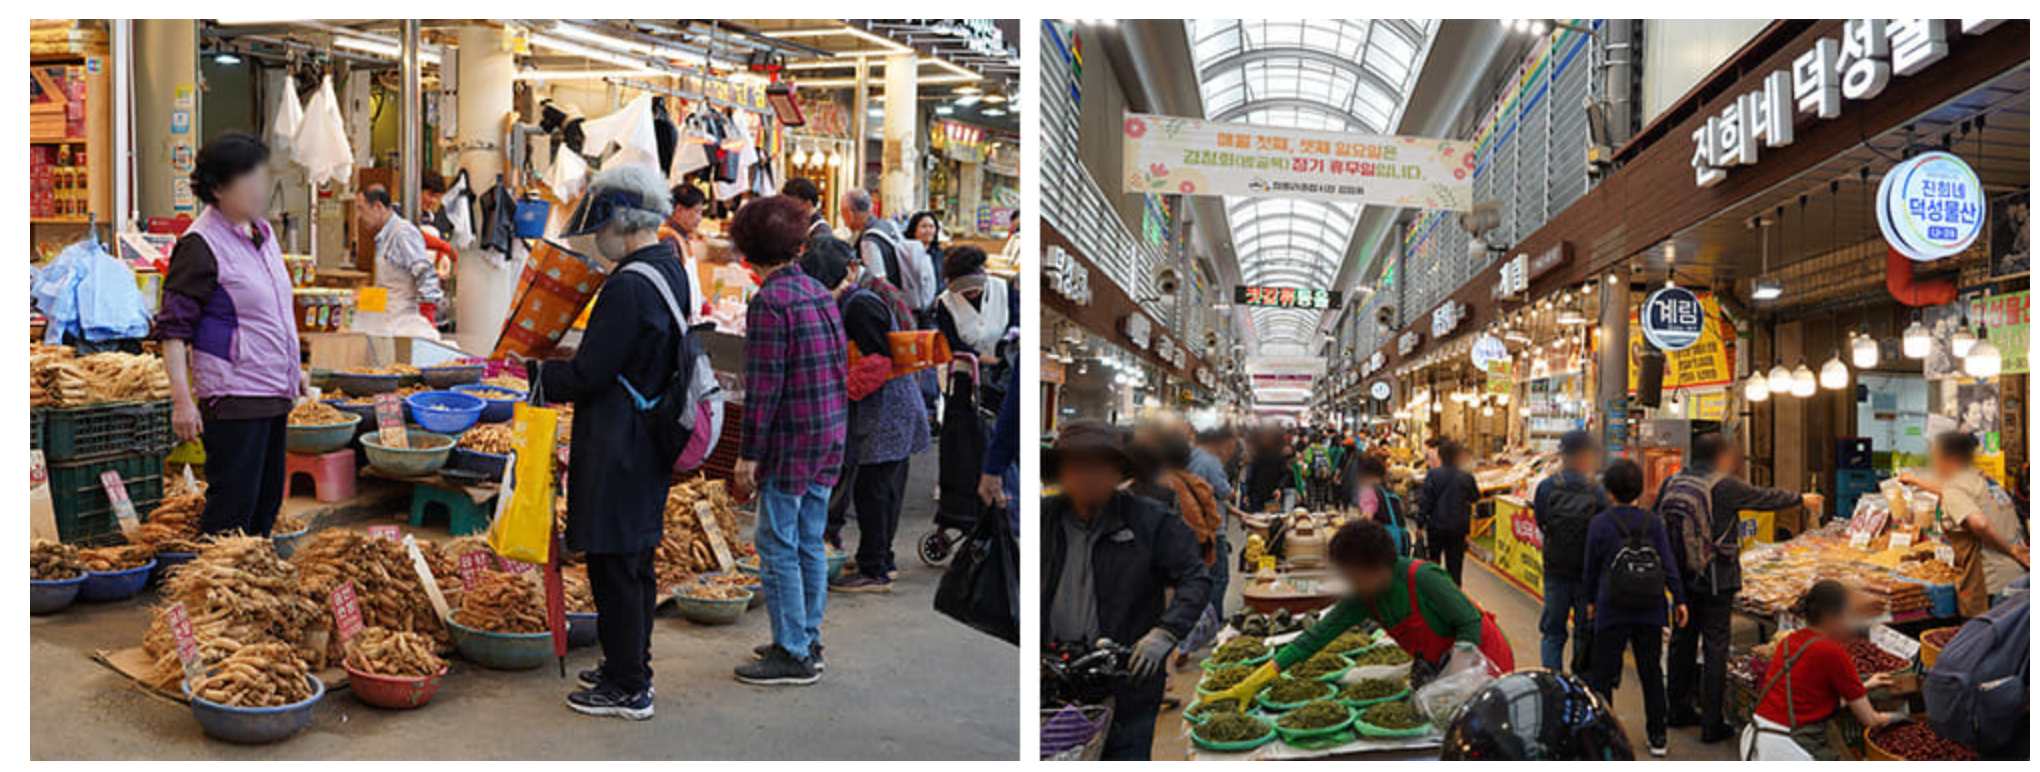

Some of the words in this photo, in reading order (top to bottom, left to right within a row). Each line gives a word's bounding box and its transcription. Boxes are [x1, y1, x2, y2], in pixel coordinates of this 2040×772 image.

[1691, 70, 1793, 186] 진희네
[1793, 18, 2007, 118] 덕성물
[1216, 132, 1251, 149] 매월
[1257, 134, 1294, 153] 첫째,
[1299, 138, 1330, 155] 셋째
[1336, 142, 1397, 160] 일요일은
[1292, 157, 1325, 173] 정기
[1330, 160, 1426, 180] 휴무일입니다.
[1921, 179, 1966, 199] 진희네
[1909, 198, 1976, 224] 덕성물산
[1655, 298, 1698, 324] 계림
